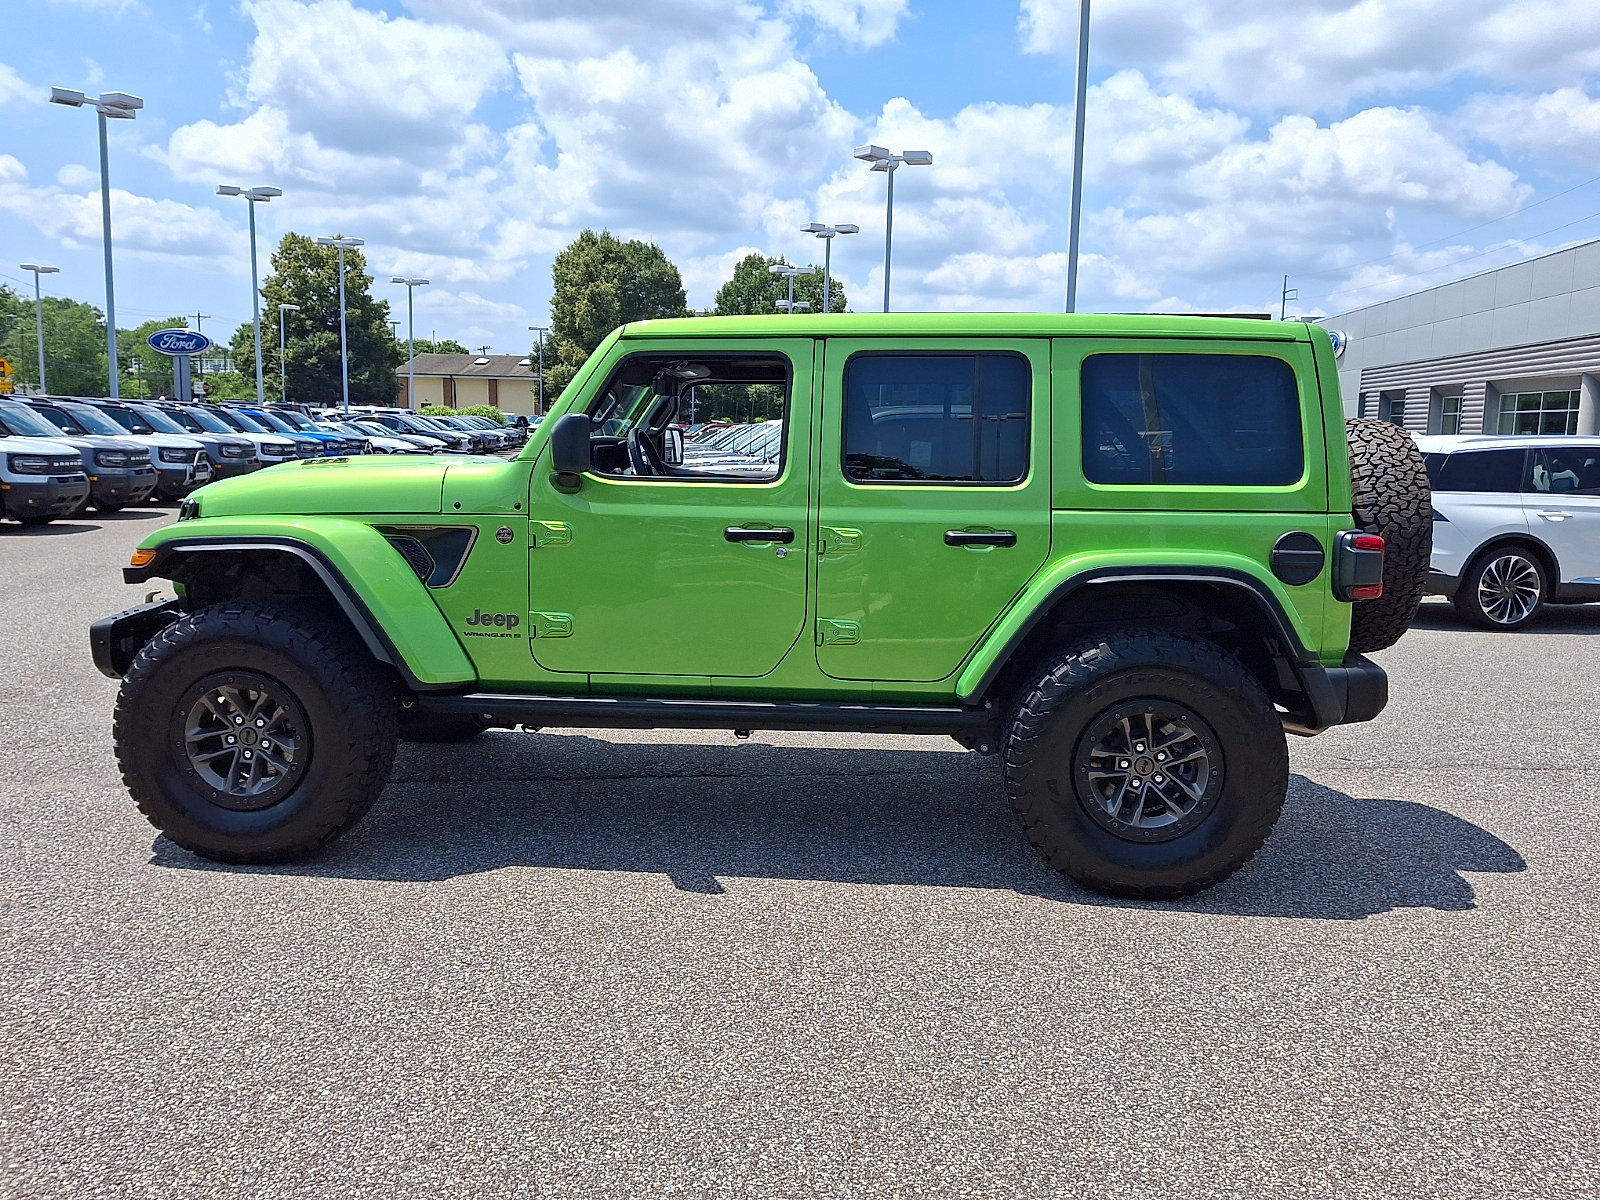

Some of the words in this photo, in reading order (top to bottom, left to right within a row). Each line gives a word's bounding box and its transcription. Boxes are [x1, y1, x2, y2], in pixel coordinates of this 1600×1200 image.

[160, 333, 197, 350] Ford
[466, 608, 520, 630] Jeep
[463, 631, 512, 639] WRANGLER
